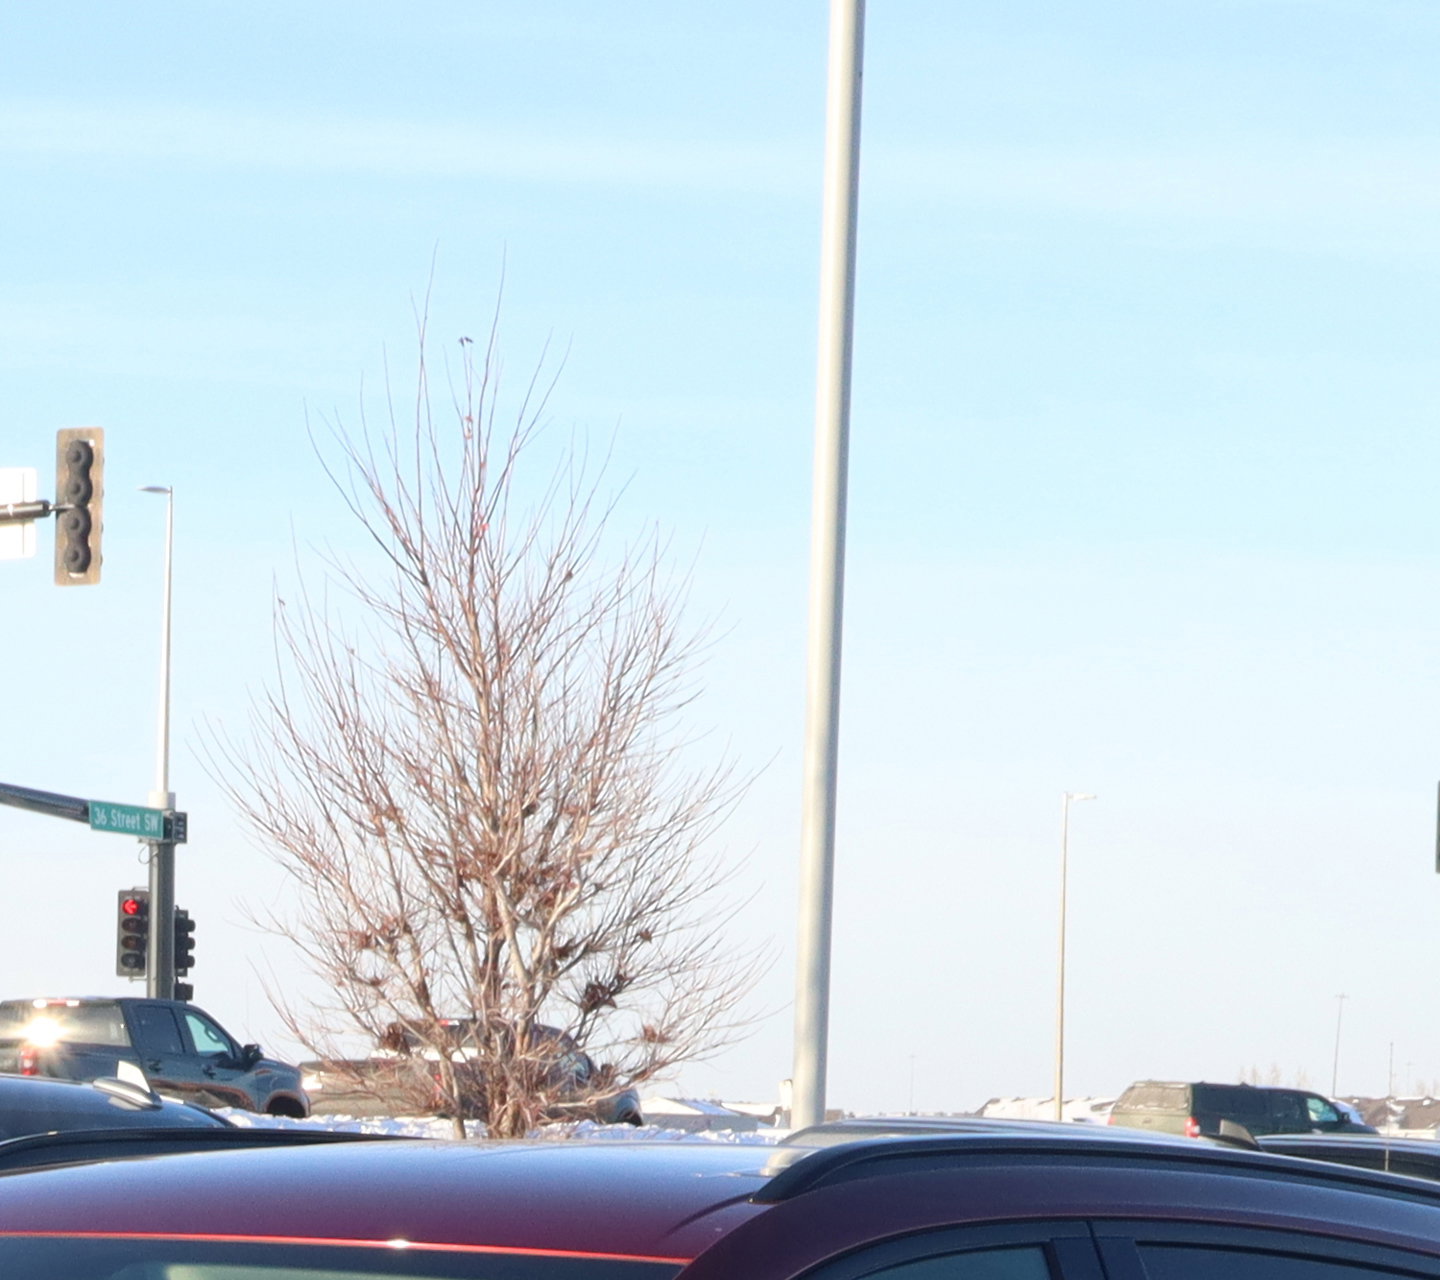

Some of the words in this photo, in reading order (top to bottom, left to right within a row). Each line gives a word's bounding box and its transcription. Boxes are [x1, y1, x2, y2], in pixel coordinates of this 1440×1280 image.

[94, 807, 107, 825] 36
[110, 809, 140, 830] Street
[144, 813, 159, 831] SW
